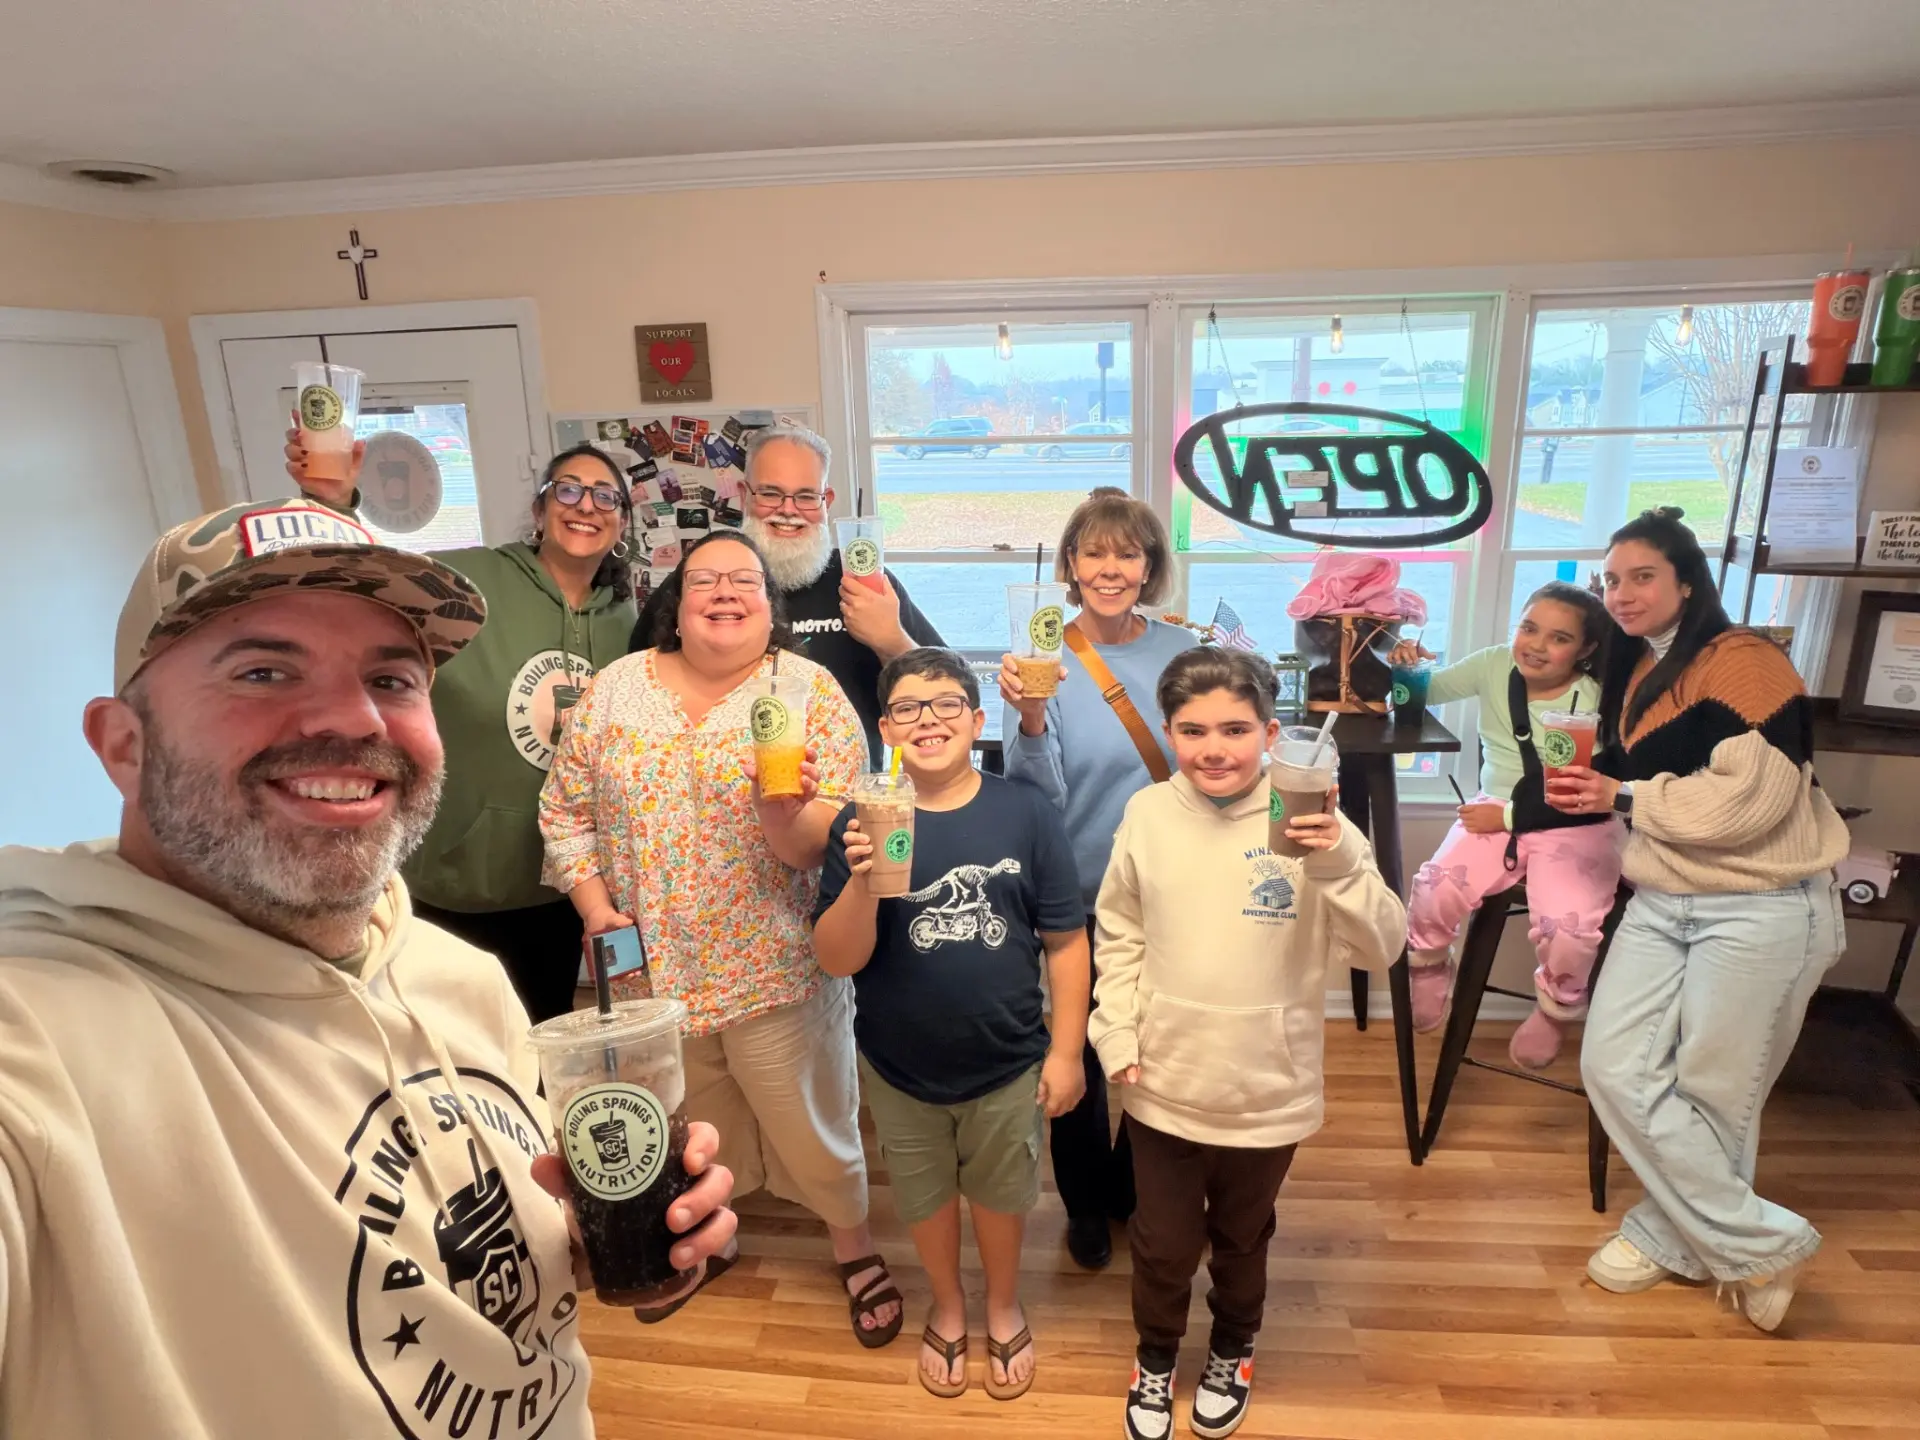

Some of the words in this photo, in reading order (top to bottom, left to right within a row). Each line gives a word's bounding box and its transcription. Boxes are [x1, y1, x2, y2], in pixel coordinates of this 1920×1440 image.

[646, 329, 692, 339] SUPPORT
[661, 357, 682, 366] OUR
[656, 388, 696, 398] LOCALS
[518, 656, 564, 697] BOILING
[1242, 909, 1279, 918] ADVENTURE
[1280, 911, 1297, 919] CLUB
[569, 1100, 599, 1138] BOILING
[602, 1097, 652, 1124] SPRINGS
[604, 1142, 620, 1155] SC
[577, 1143, 657, 1188] NUTRITION
[359, 1115, 427, 1292] BILNG
[483, 1259, 519, 1317] SC
